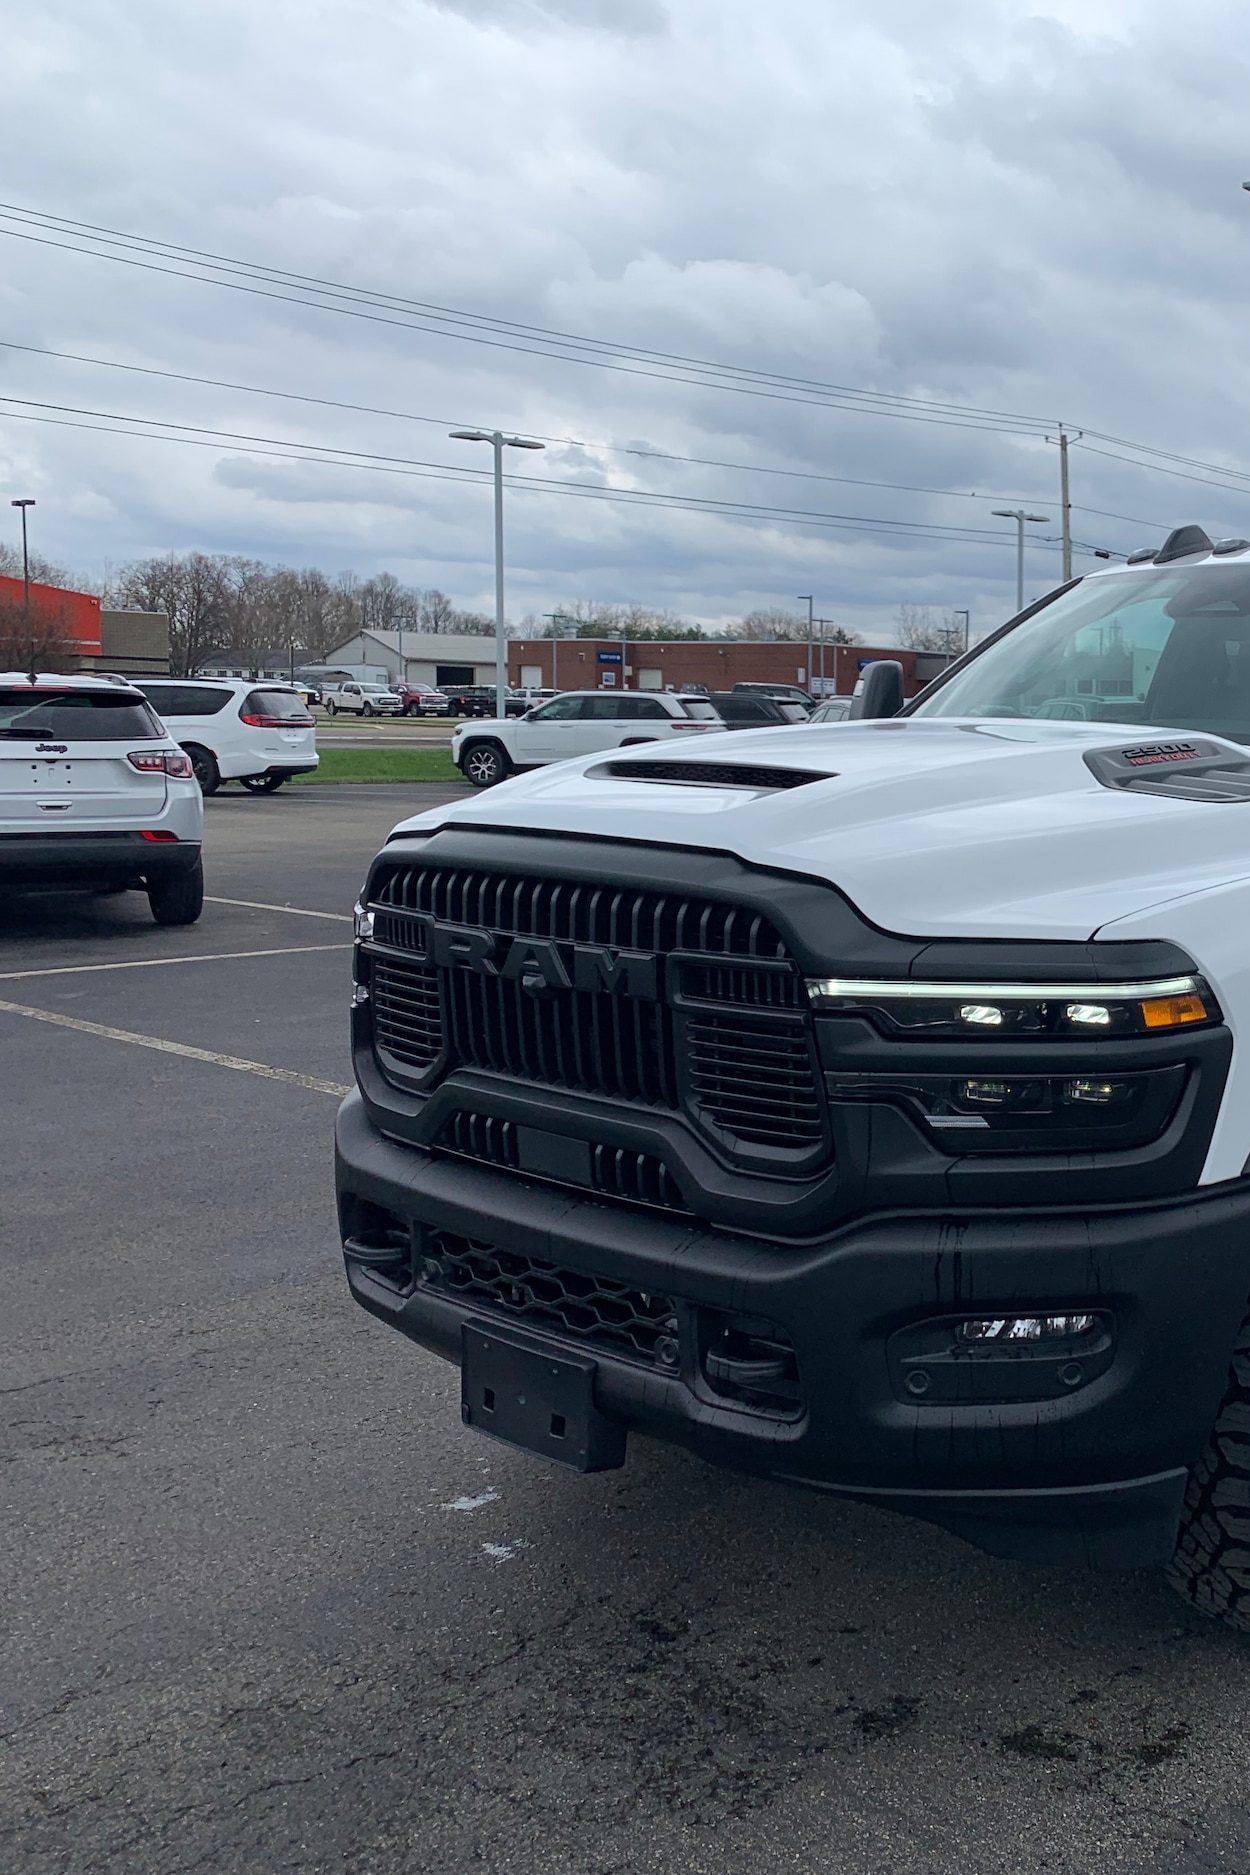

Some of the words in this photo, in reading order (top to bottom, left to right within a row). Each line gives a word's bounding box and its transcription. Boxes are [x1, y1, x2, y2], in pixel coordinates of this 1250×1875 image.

[35, 743, 68, 754] Jeep
[1121, 743, 1196, 759] 2500
[1129, 754, 1169, 766] HEAVY
[1169, 751, 1201, 761] DUTY
[434, 923, 657, 1000] RAM
